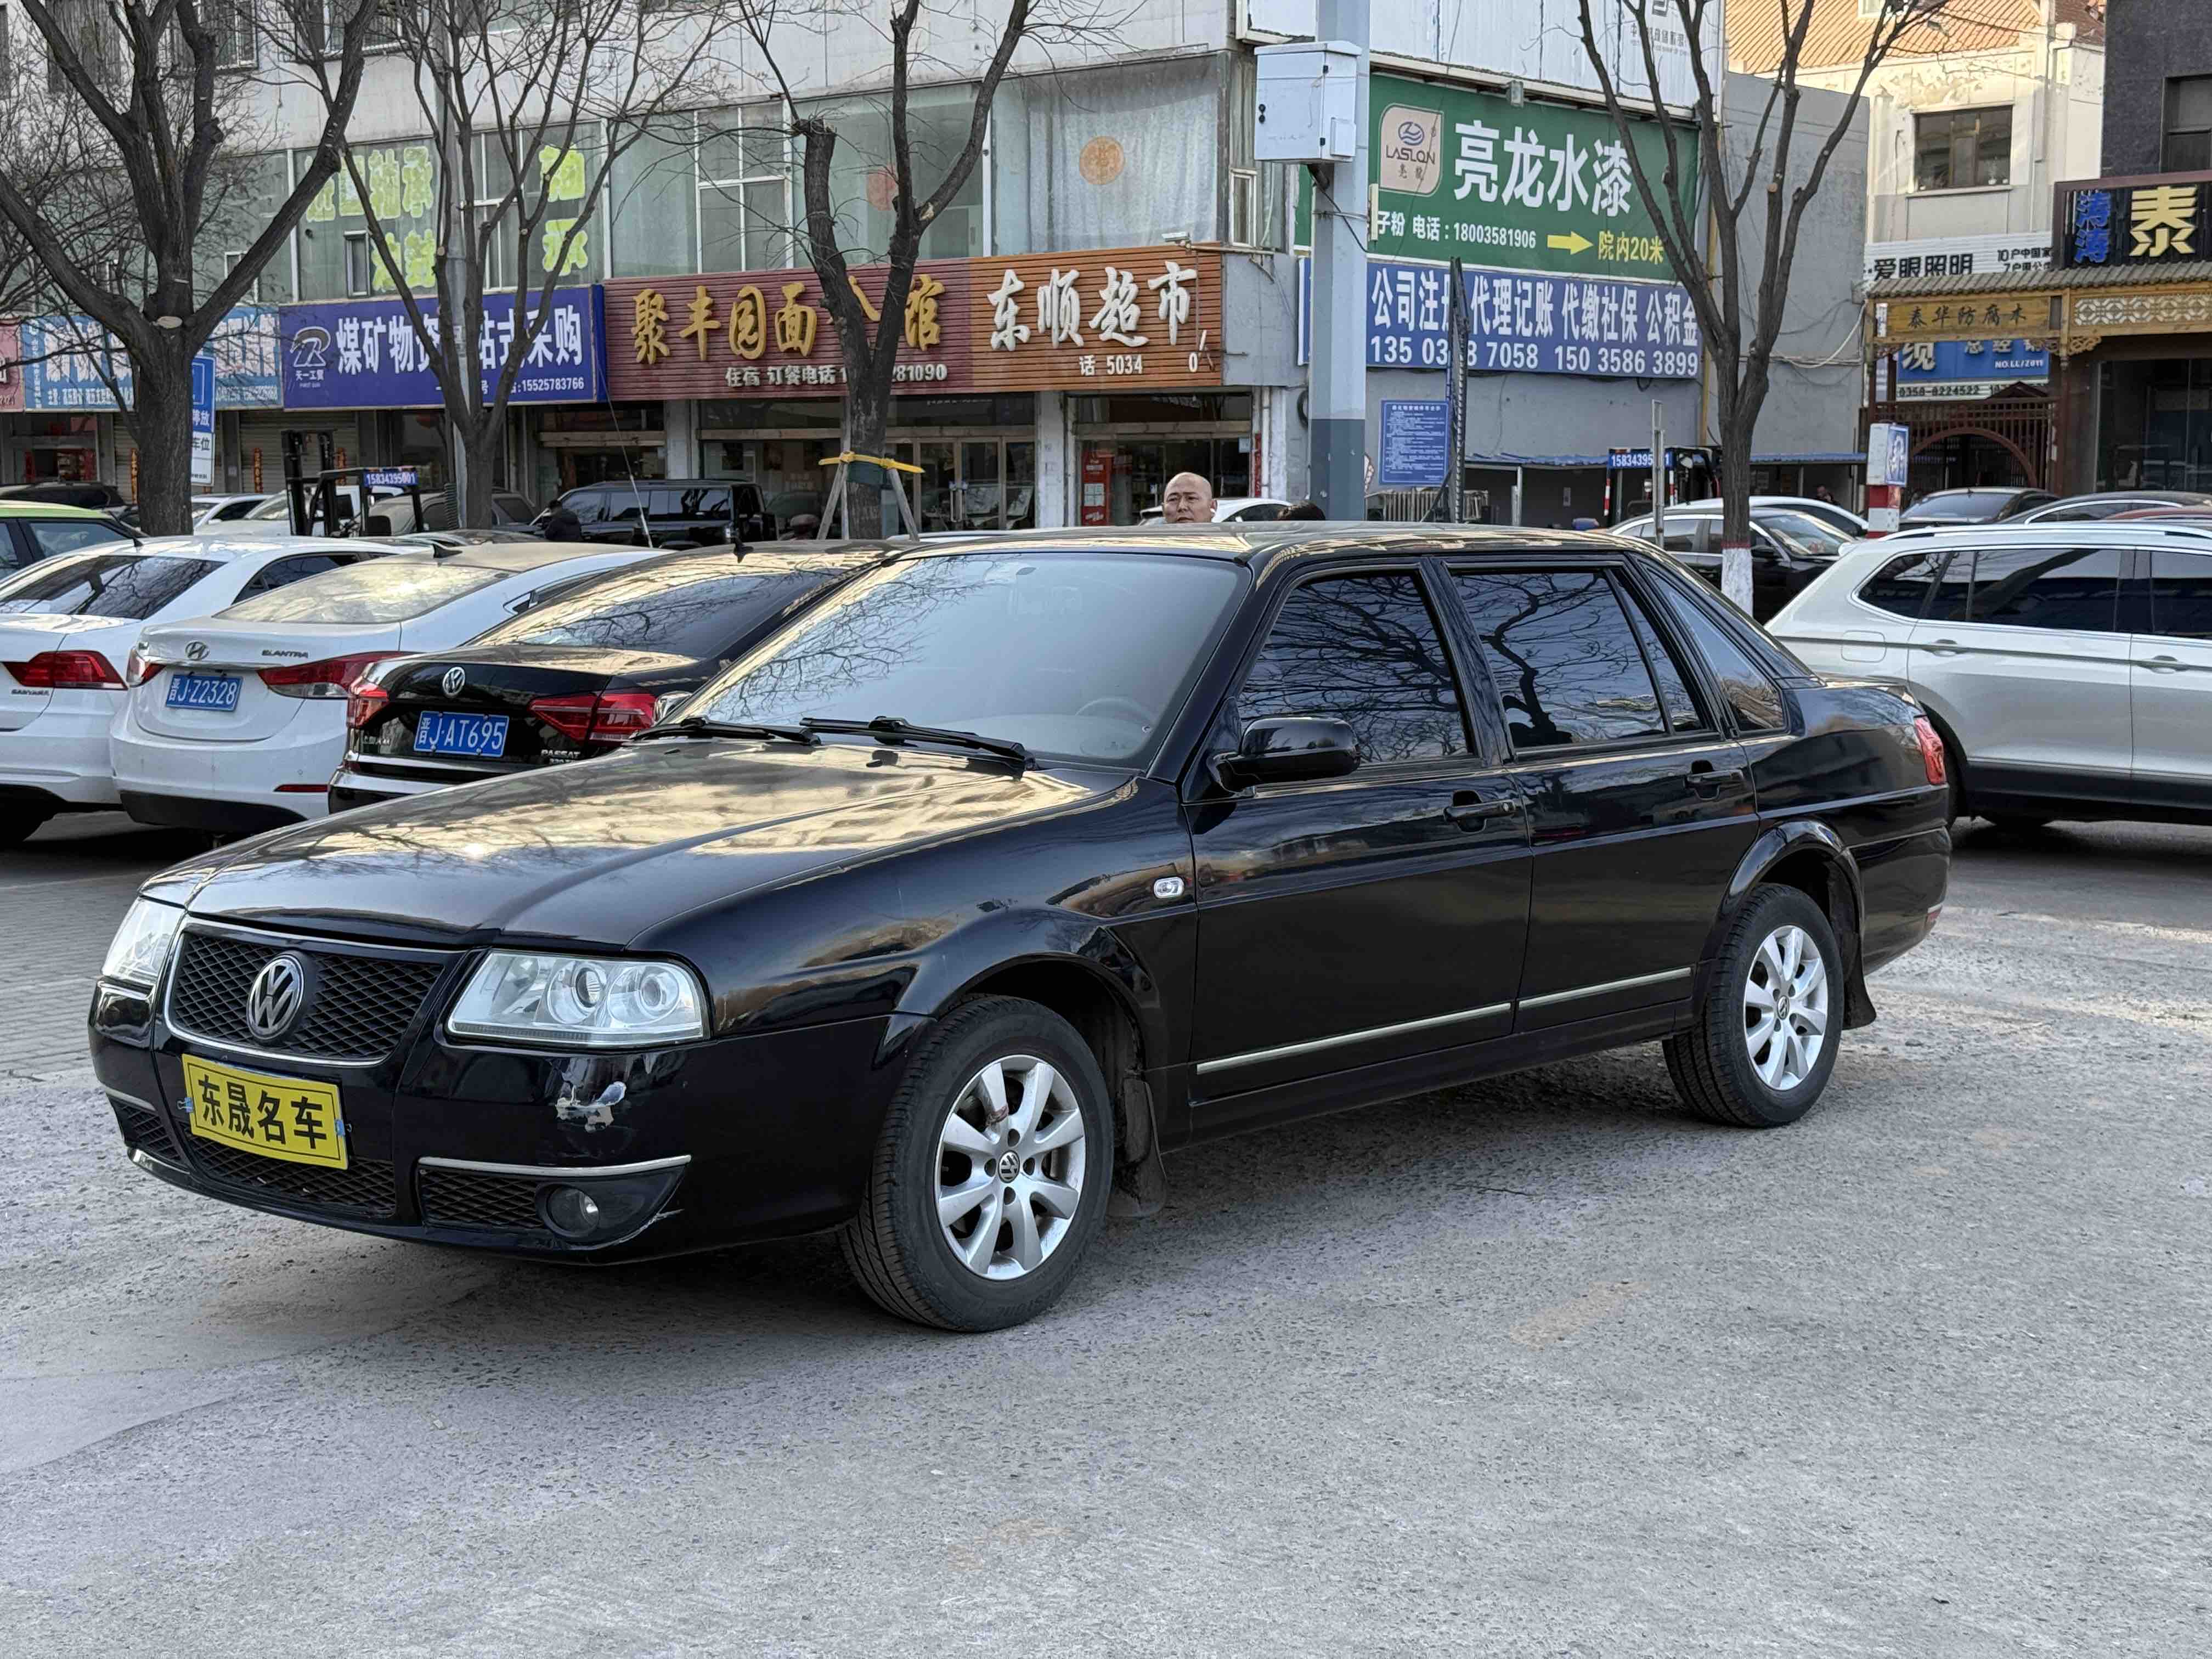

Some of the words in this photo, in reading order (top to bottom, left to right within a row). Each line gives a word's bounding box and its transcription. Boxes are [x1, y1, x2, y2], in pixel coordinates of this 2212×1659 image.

[1454, 120, 1632, 217] 亮龙水漆
[1368, 210, 1406, 236] 子粉
[2129, 185, 2197, 257] 泰
[1598, 230, 1664, 264] 院内20米
[1874, 253, 1973, 281] 爱眼照明
[631, 274, 945, 364] 聚丰园面馆
[987, 261, 1198, 352] 东顺超市
[1471, 275, 1554, 337] 代理记账
[1562, 283, 1638, 344] 代缴社保
[1645, 290, 1699, 347] 公积金
[336, 305, 583, 375] 煤矿物资站式采购
[1371, 335, 1413, 363] 135
[1422, 337, 1477, 366] 038
[1486, 341, 1538, 369] 7058
[1554, 345, 1590, 371] 150
[1598, 347, 1646, 374] 3586
[1652, 351, 1698, 376] 3899
[725, 367, 760, 387] 住宿
[767, 365, 836, 385] 订餐电话
[1079, 354, 1096, 376] 话
[1611, 453, 1670, 467] 158343951
[541, 749, 581, 759] PASSAT
[198, 1074, 328, 1150] 东晟名车
